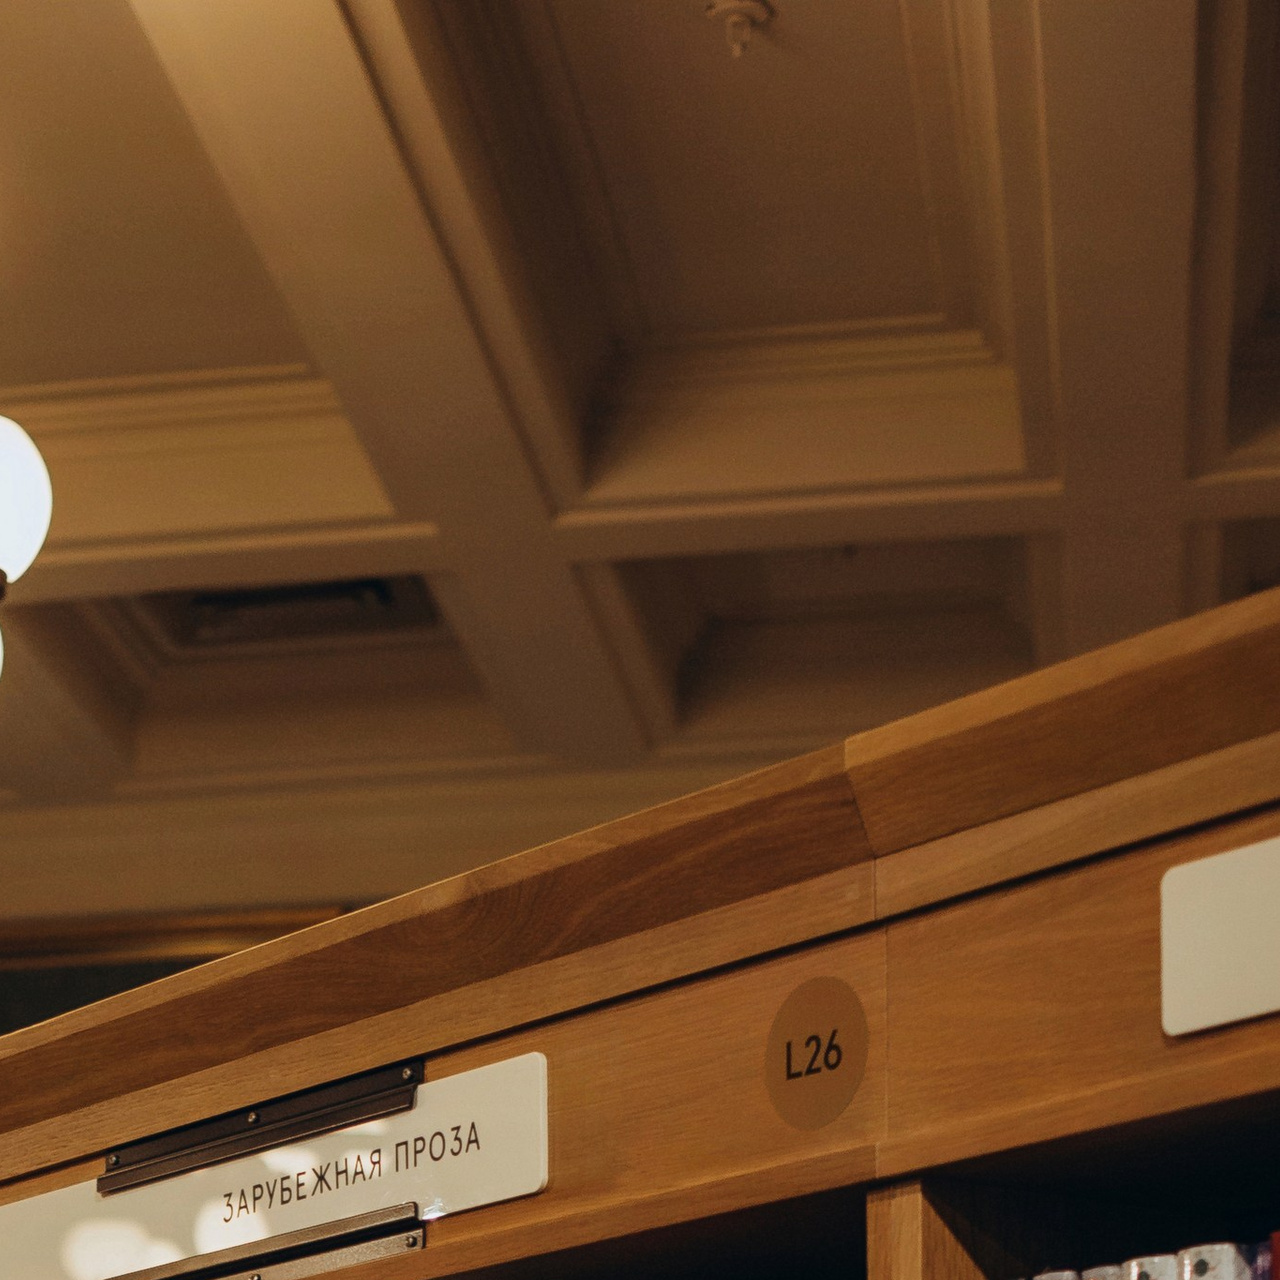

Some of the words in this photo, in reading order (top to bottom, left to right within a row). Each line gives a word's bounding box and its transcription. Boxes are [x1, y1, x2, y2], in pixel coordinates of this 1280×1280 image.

[785, 1030, 843, 1081] L26
[223, 1148, 383, 1223] ЗАРУБЕЖНАЯ
[395, 1122, 481, 1172] ПРОЗА
